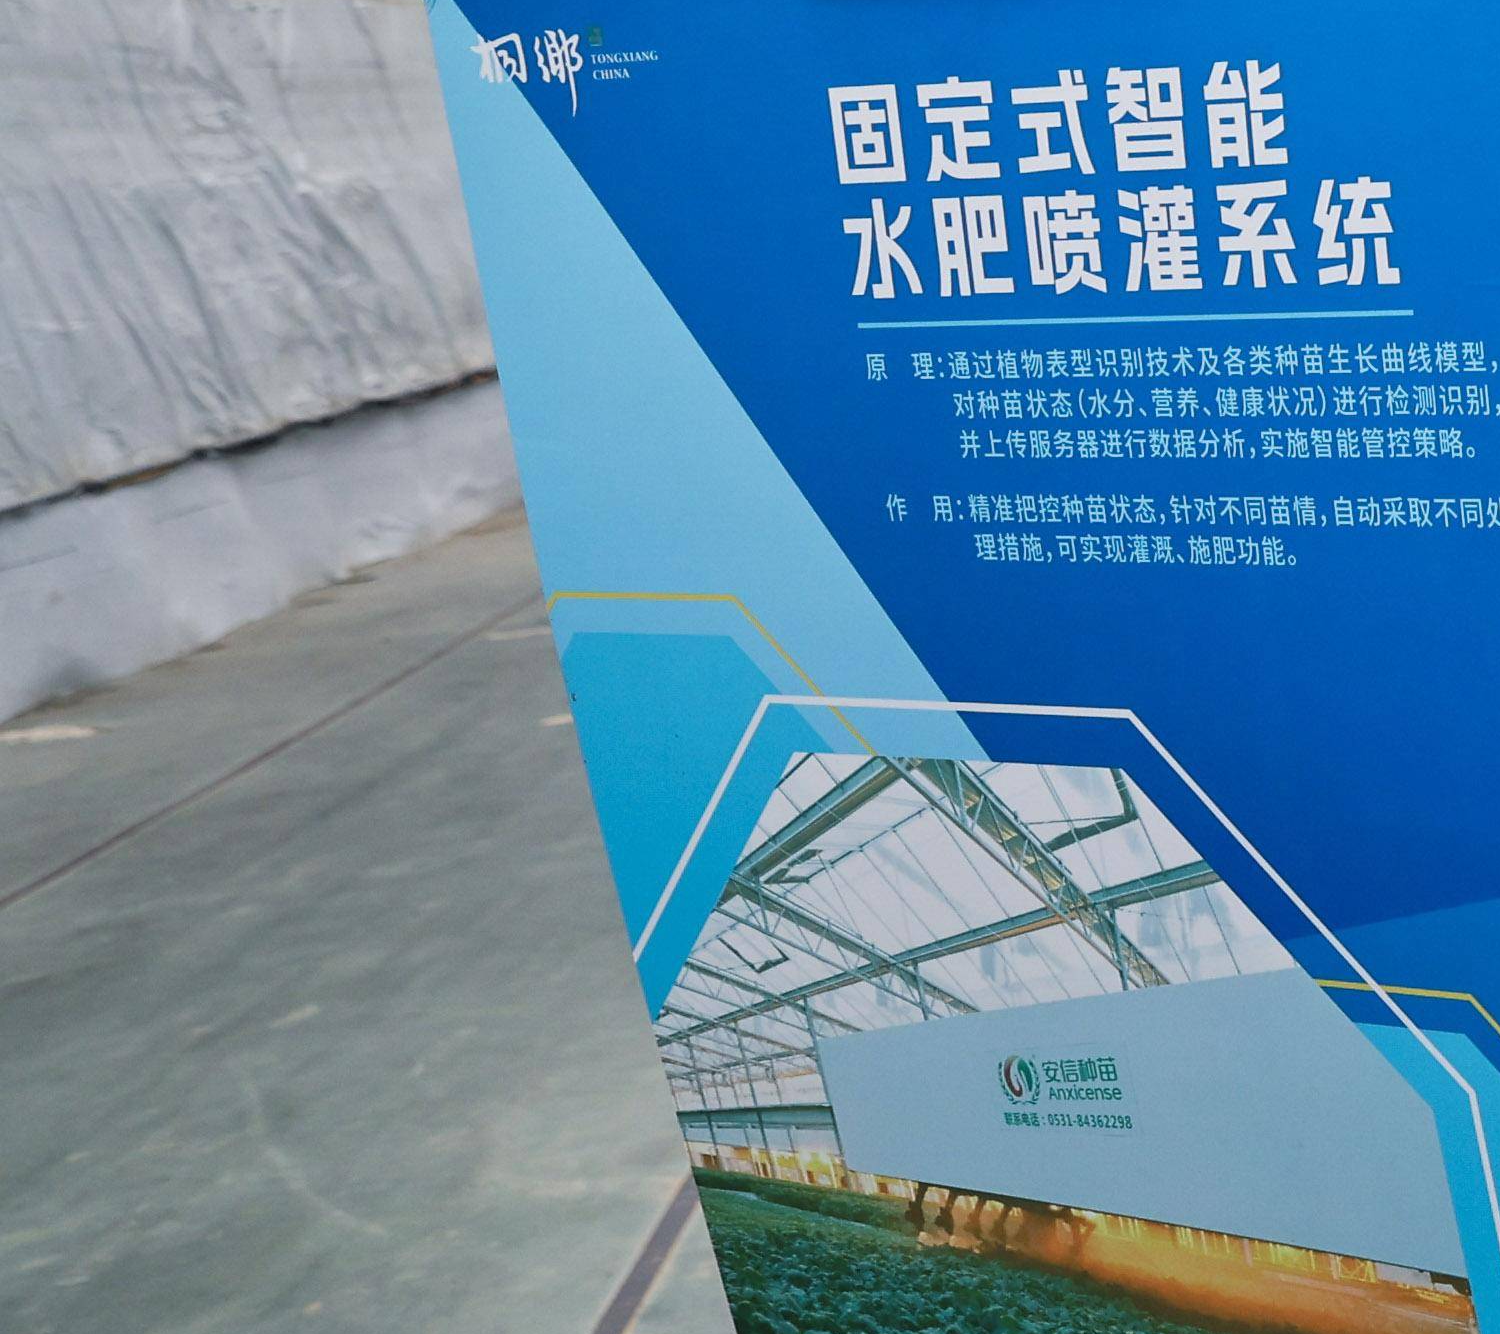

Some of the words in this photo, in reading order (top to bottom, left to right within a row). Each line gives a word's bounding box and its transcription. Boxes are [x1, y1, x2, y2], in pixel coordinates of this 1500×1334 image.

[590, 50, 659, 65] TONGXIANG
[592, 68, 630, 80] CHINA
[828, 59, 1288, 185] 固定式智能
[842, 175, 1401, 299] 水肥喷灌系统
[1042, 1056, 1118, 1083] 安信种苗
[1049, 1084, 1122, 1100] Anxicense
